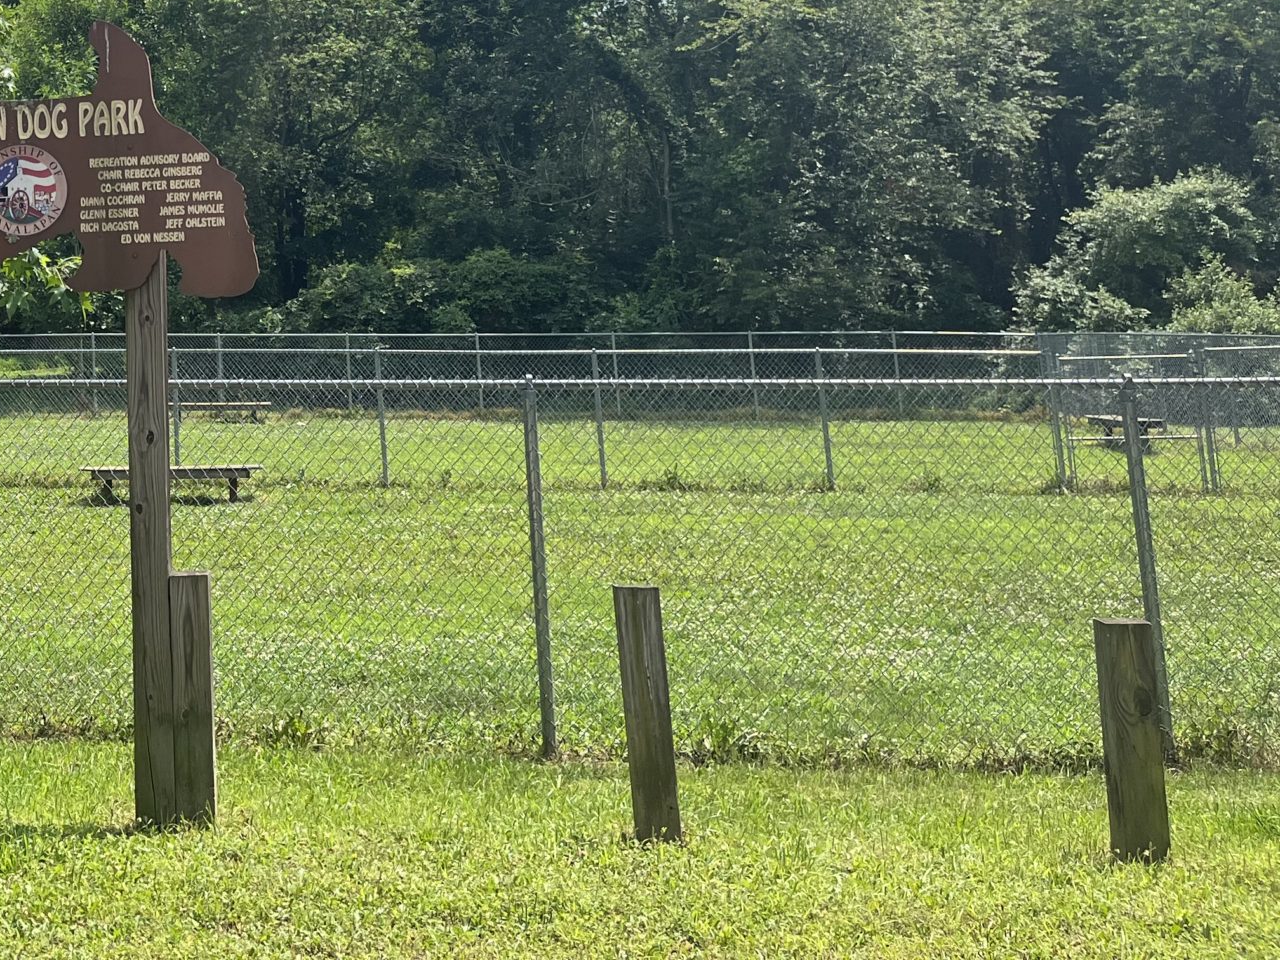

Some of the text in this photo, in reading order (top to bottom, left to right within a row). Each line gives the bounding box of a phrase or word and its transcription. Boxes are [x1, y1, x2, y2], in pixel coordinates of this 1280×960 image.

[17, 102, 68, 140] DOG
[78, 98, 145, 137] PARK
[89, 152, 210, 168] RECREATION ADVISORY BOARD
[49, 161, 62, 176] OF
[98, 166, 202, 180] CHAIR REBECCA GINSBERG
[100, 179, 200, 192] CO-CHAIR PETER BECKER
[80, 194, 145, 207] DIANA COCHRAN
[166, 190, 222, 202] JERRY MAFFIA
[80, 208, 139, 220] GLENN ESSNER
[160, 206, 185, 216] JAMES
[80, 220, 139, 232] RICH DAGOSTA
[166, 216, 225, 228] JEFF OHLSTEIN
[121, 232, 185, 244] ED VON NESSEN
